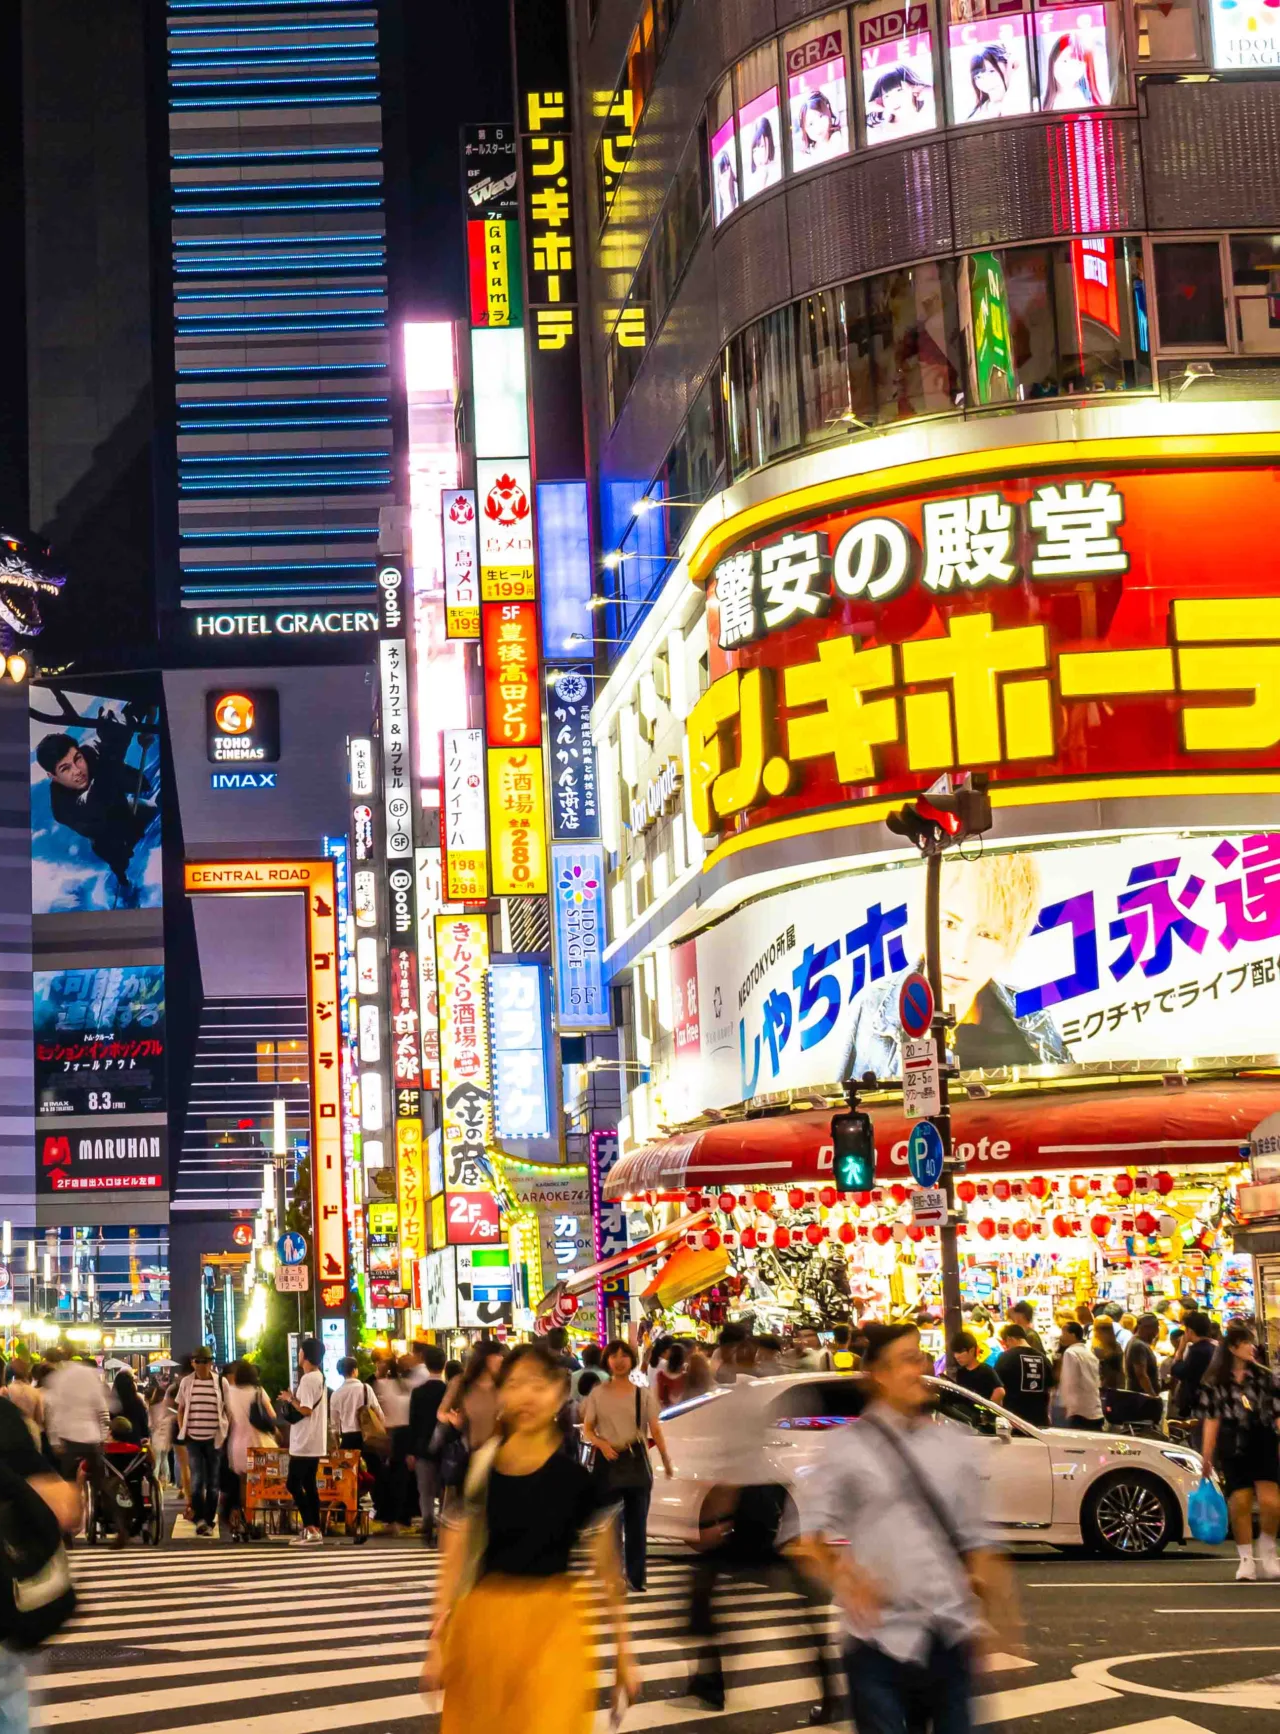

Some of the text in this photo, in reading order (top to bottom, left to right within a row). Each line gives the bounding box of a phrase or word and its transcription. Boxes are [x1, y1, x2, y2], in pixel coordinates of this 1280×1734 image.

[487, 212, 502, 220] 7F
[489, 225, 508, 303] Garam
[479, 310, 518, 322] ガラム
[487, 569, 533, 581] 生ビール
[715, 480, 1130, 650] 驚安の殿堂
[379, 567, 402, 629] Booth
[501, 605, 520, 620] 5F
[196, 613, 380, 637] HOTEL GRACERY
[498, 623, 528, 742] 豊後高田どり
[388, 647, 403, 789] ネットカフェ & カプセル
[468, 732, 480, 742] 4F
[215, 737, 250, 749] TOHO
[215, 749, 264, 760] CINEMAS
[213, 774, 276, 788] IMAX
[504, 773, 534, 814] 酒場
[392, 803, 406, 847] 8F 5F
[192, 868, 311, 882] CENTRAL ROAD
[511, 829, 530, 882] 280
[389, 869, 412, 932] Booth
[567, 909, 582, 968] STAGE
[582, 909, 596, 957] IDOL
[452, 922, 477, 1048] きんくら酒場
[570, 986, 596, 1005] 5F
[1062, 955, 1280, 1045] ミクチャでライブ配
[394, 1009, 419, 1080] 甘太郎
[499, 971, 541, 1129] カラオケ
[88, 1091, 111, 1110] 8.3
[314, 952, 338, 1220] ゴジラロード
[399, 1090, 418, 1102] 4F
[399, 1104, 418, 1116] 3F
[78, 1137, 160, 1160] MARUHAN
[915, 1138, 928, 1178] P
[449, 1196, 482, 1224] 2F
